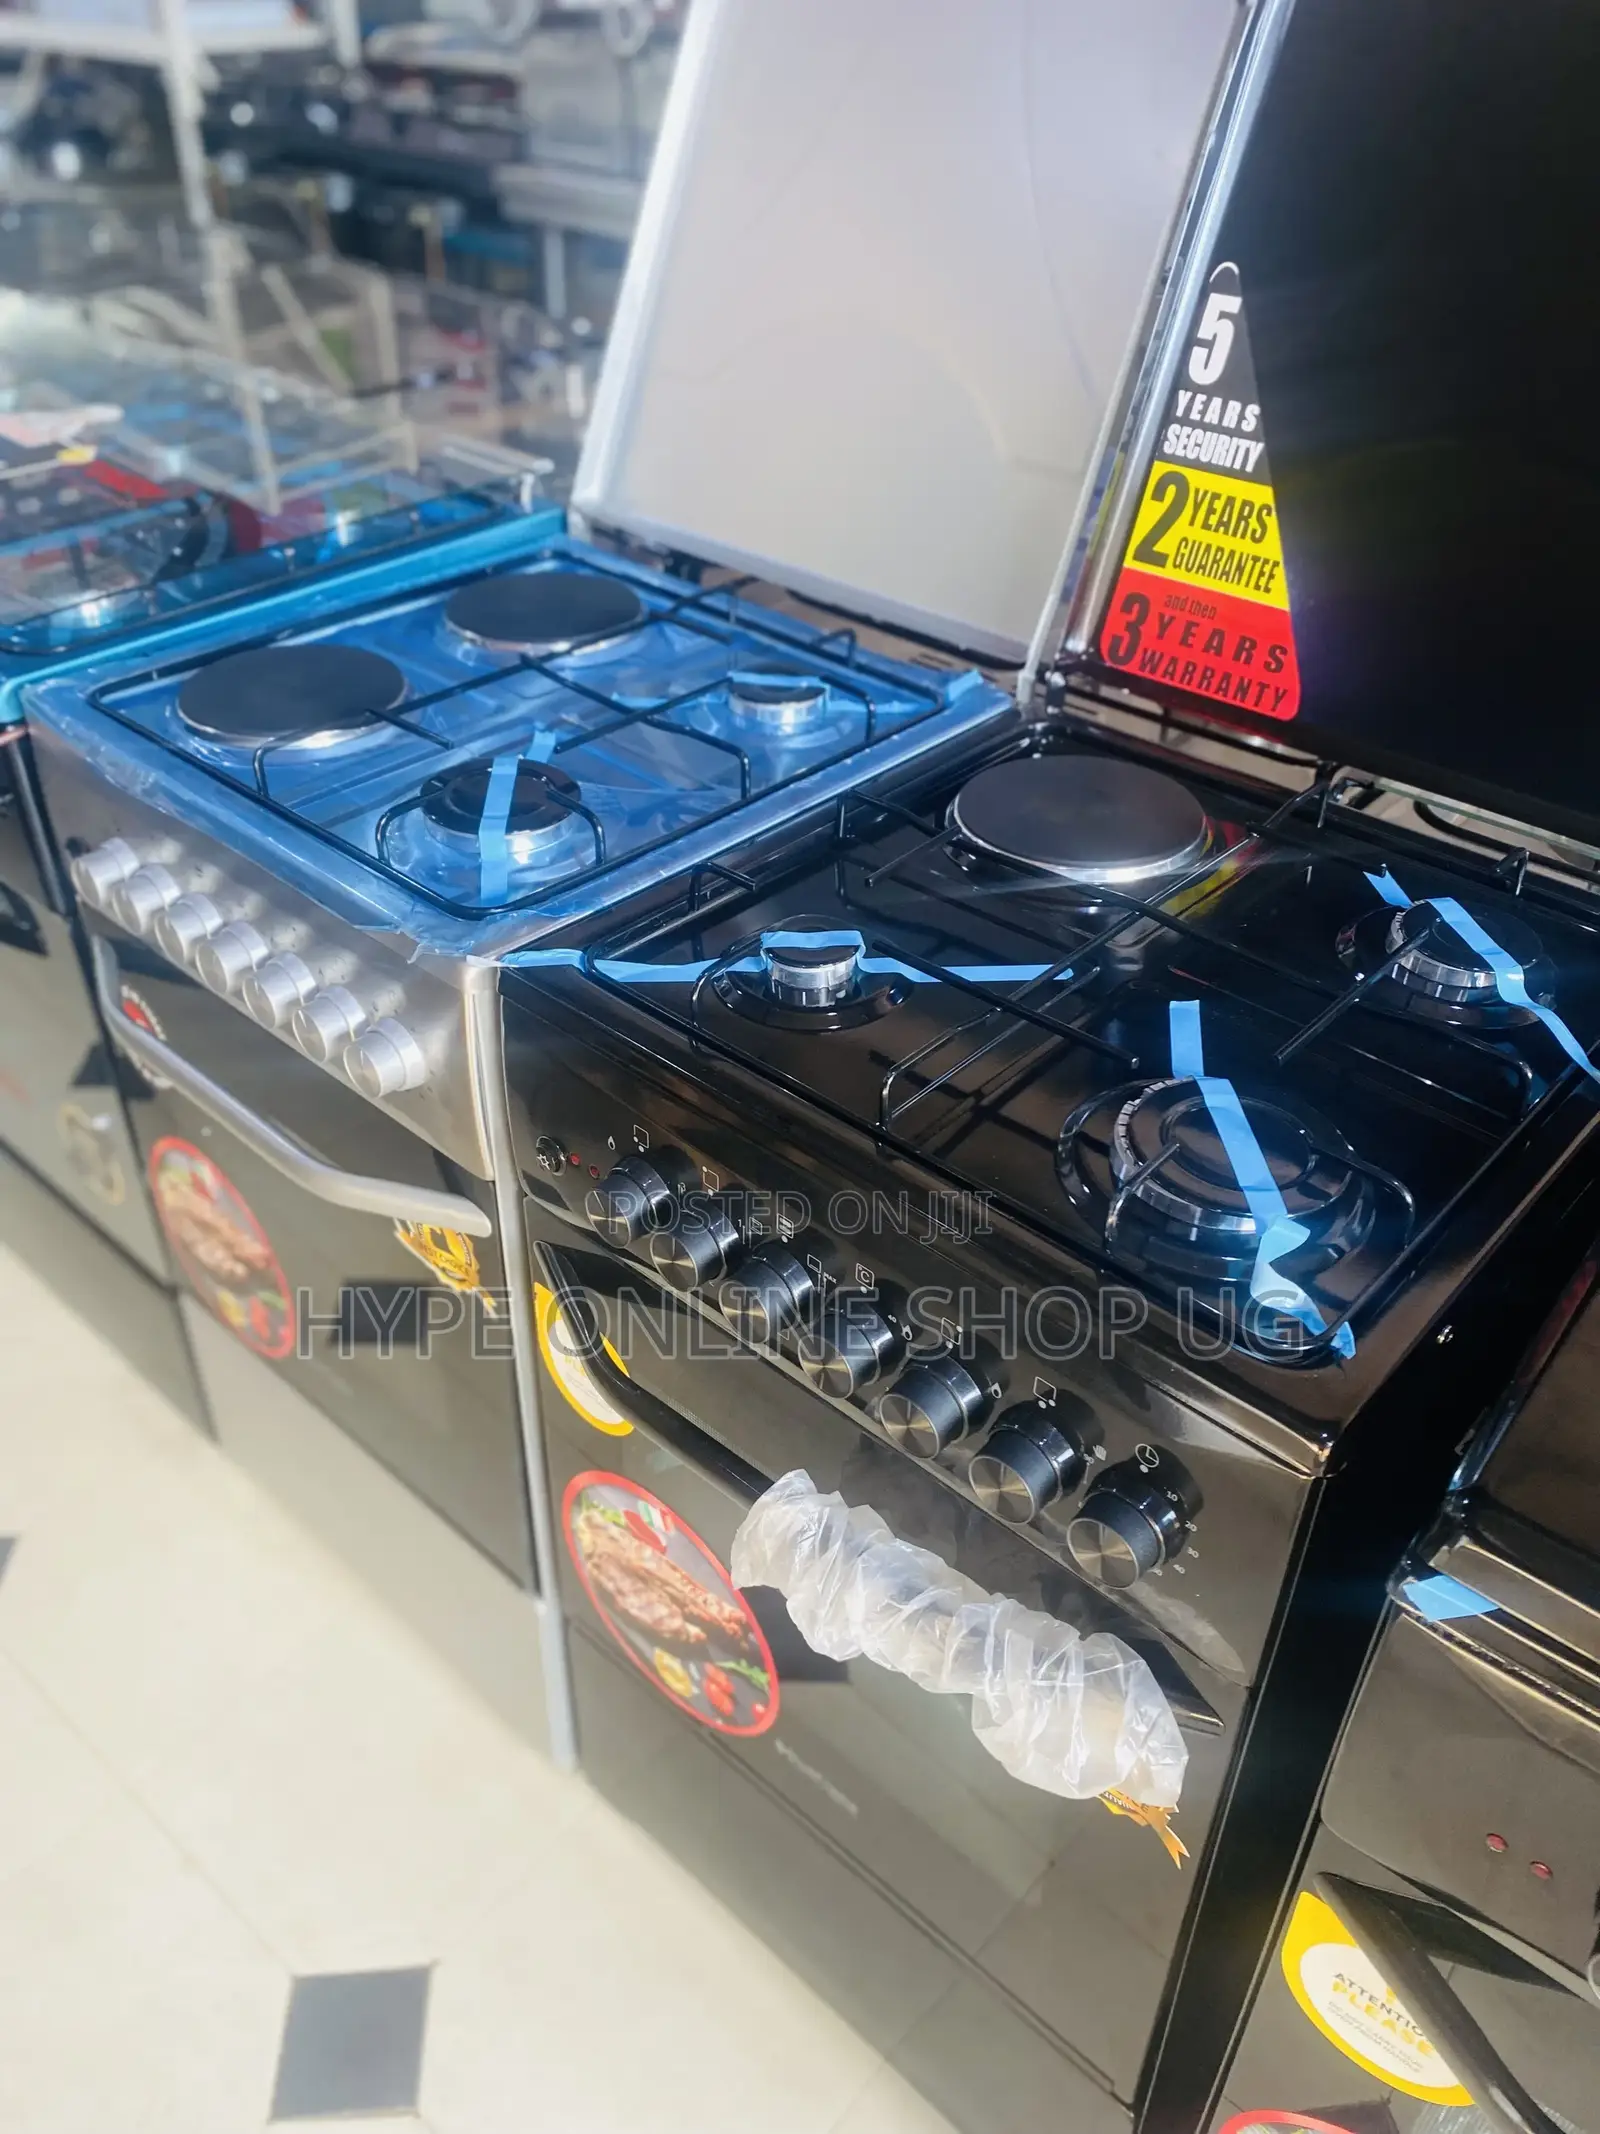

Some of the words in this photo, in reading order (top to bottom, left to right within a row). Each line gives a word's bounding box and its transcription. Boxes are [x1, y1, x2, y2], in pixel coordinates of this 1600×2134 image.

[1188, 292, 1243, 385] 5
[1175, 389, 1261, 433] YEARS
[1163, 423, 1265, 473] SECURITY
[1131, 469, 1190, 570] 2
[1187, 487, 1273, 545] YEARS
[1172, 535, 1281, 595] GUARANTEE
[1108, 591, 1150, 666] 3
[1155, 611, 1289, 674] YEARS
[1163, 594, 1188, 612] and
[1188, 598, 1218, 621] then
[1137, 647, 1289, 713] WARRANTY
[1166, 1490, 1179, 1502] 10
[1184, 1520, 1198, 1532] 20
[1333, 1972, 1425, 2037] ATTENTIO
